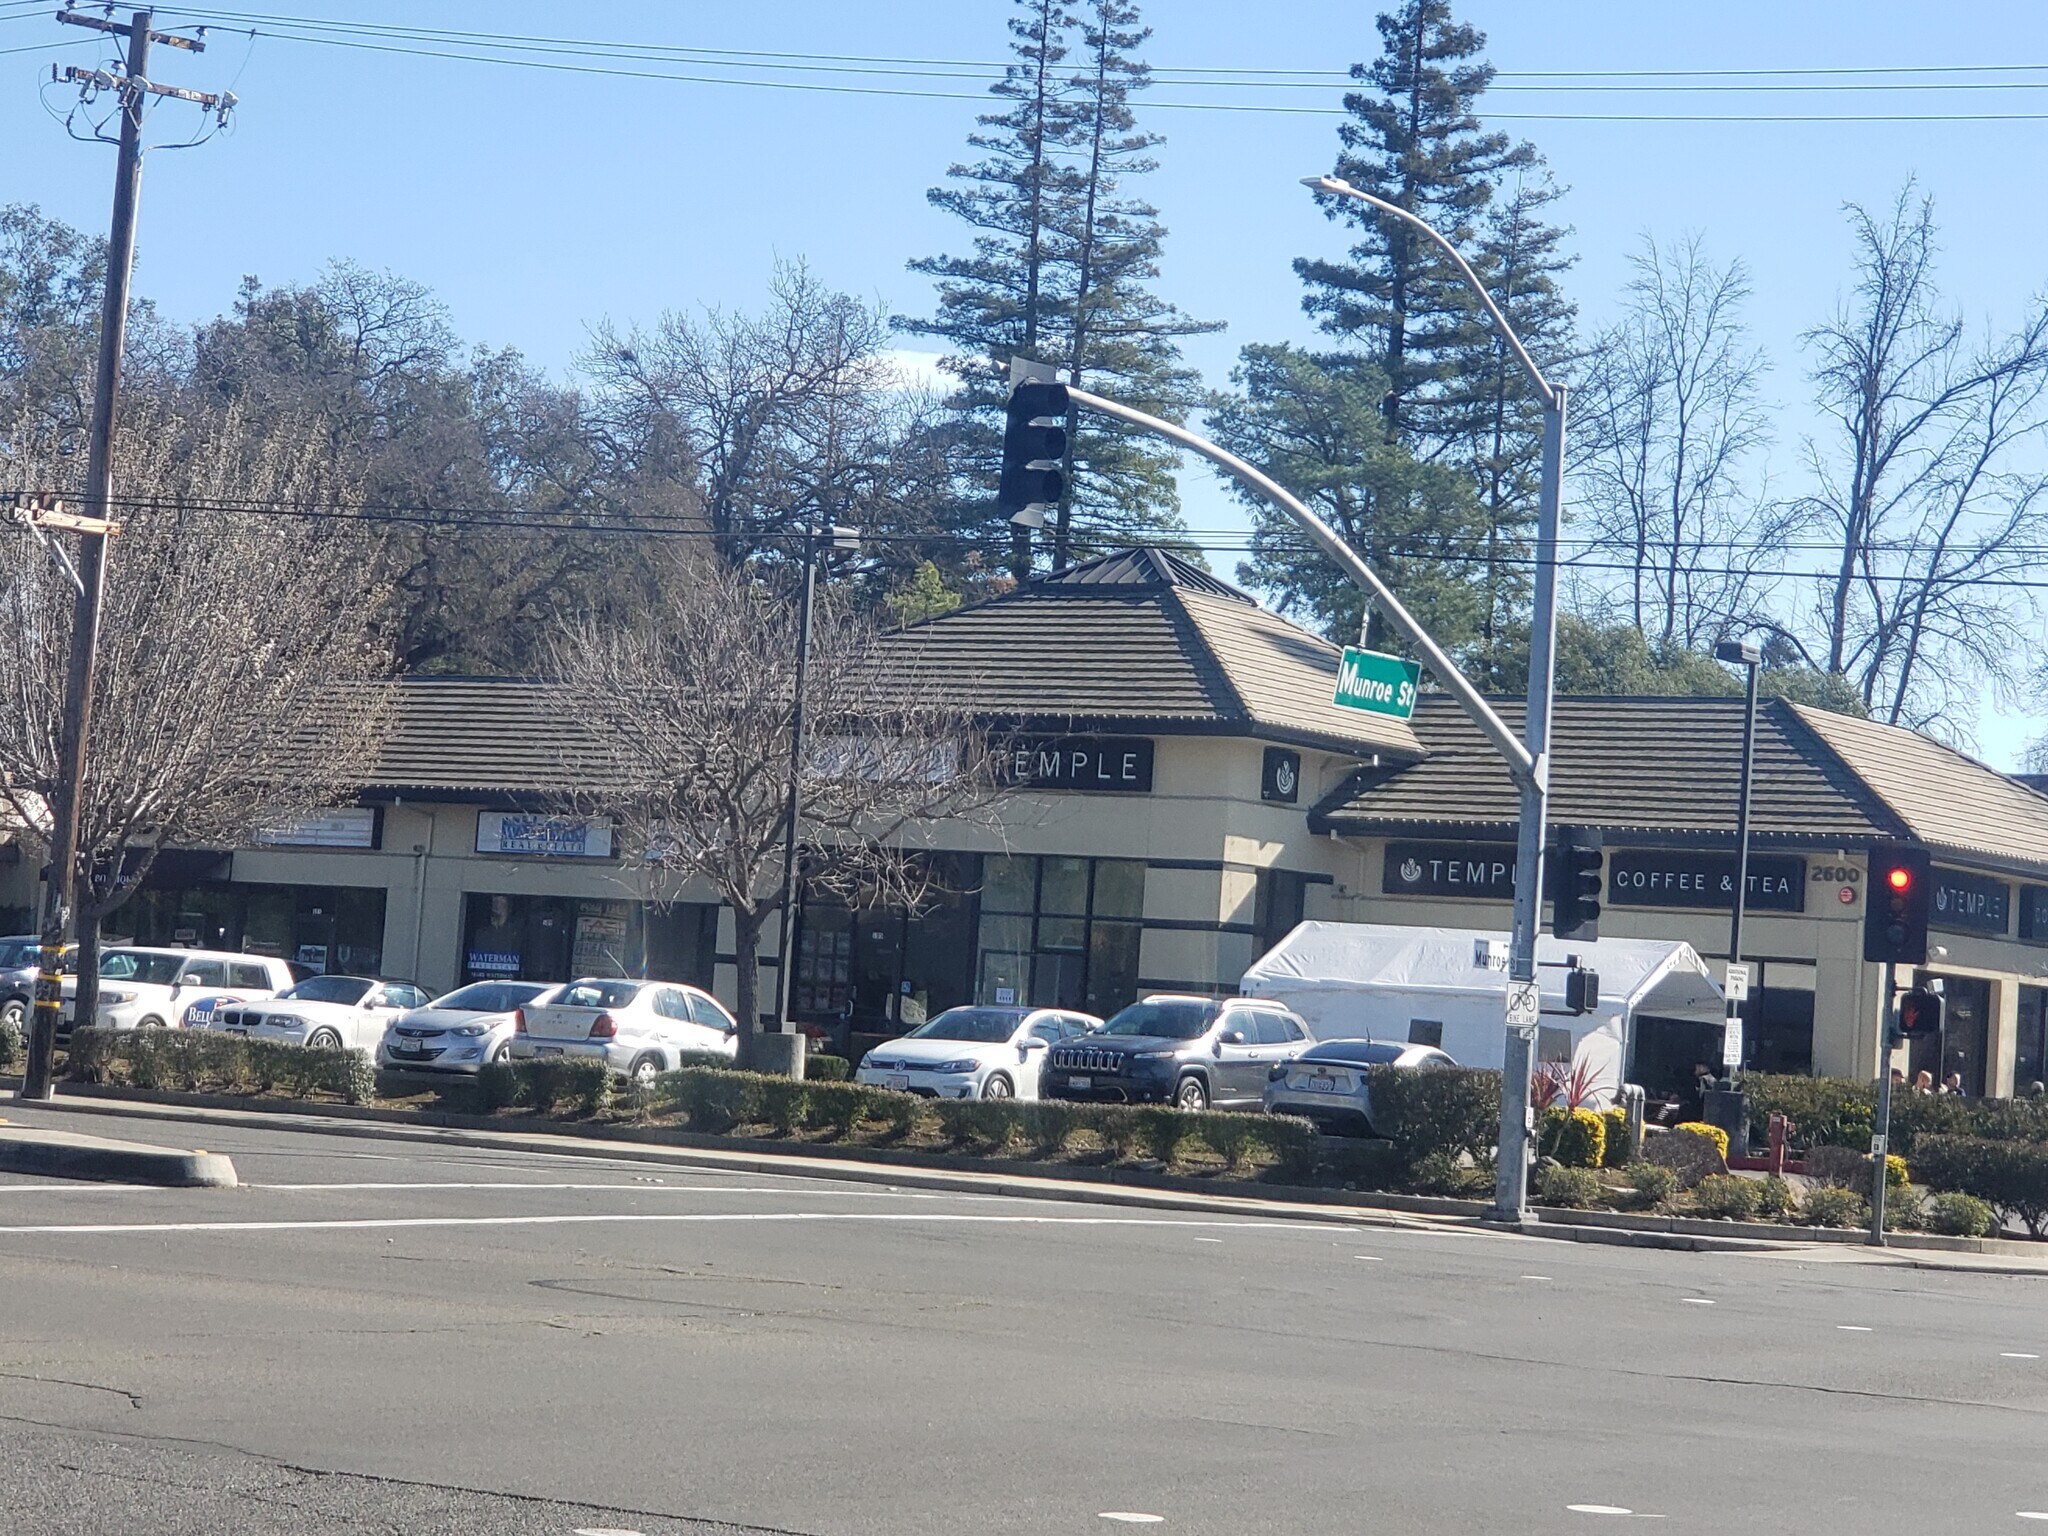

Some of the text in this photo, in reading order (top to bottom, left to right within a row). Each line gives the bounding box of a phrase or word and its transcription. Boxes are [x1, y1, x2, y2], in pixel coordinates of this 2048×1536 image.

[1338, 661, 1414, 707] Munroe St
[1429, 860, 1517, 885] TEMPL
[1616, 871, 1789, 894] COFFEE & TEA
[1811, 865, 1860, 883] 2600
[1949, 888, 2000, 919] TEMPLE
[470, 952, 520, 964] WATERMAN
[1475, 949, 1506, 968] Munroe
[1509, 1014, 1535, 1023] BIKE LANE
